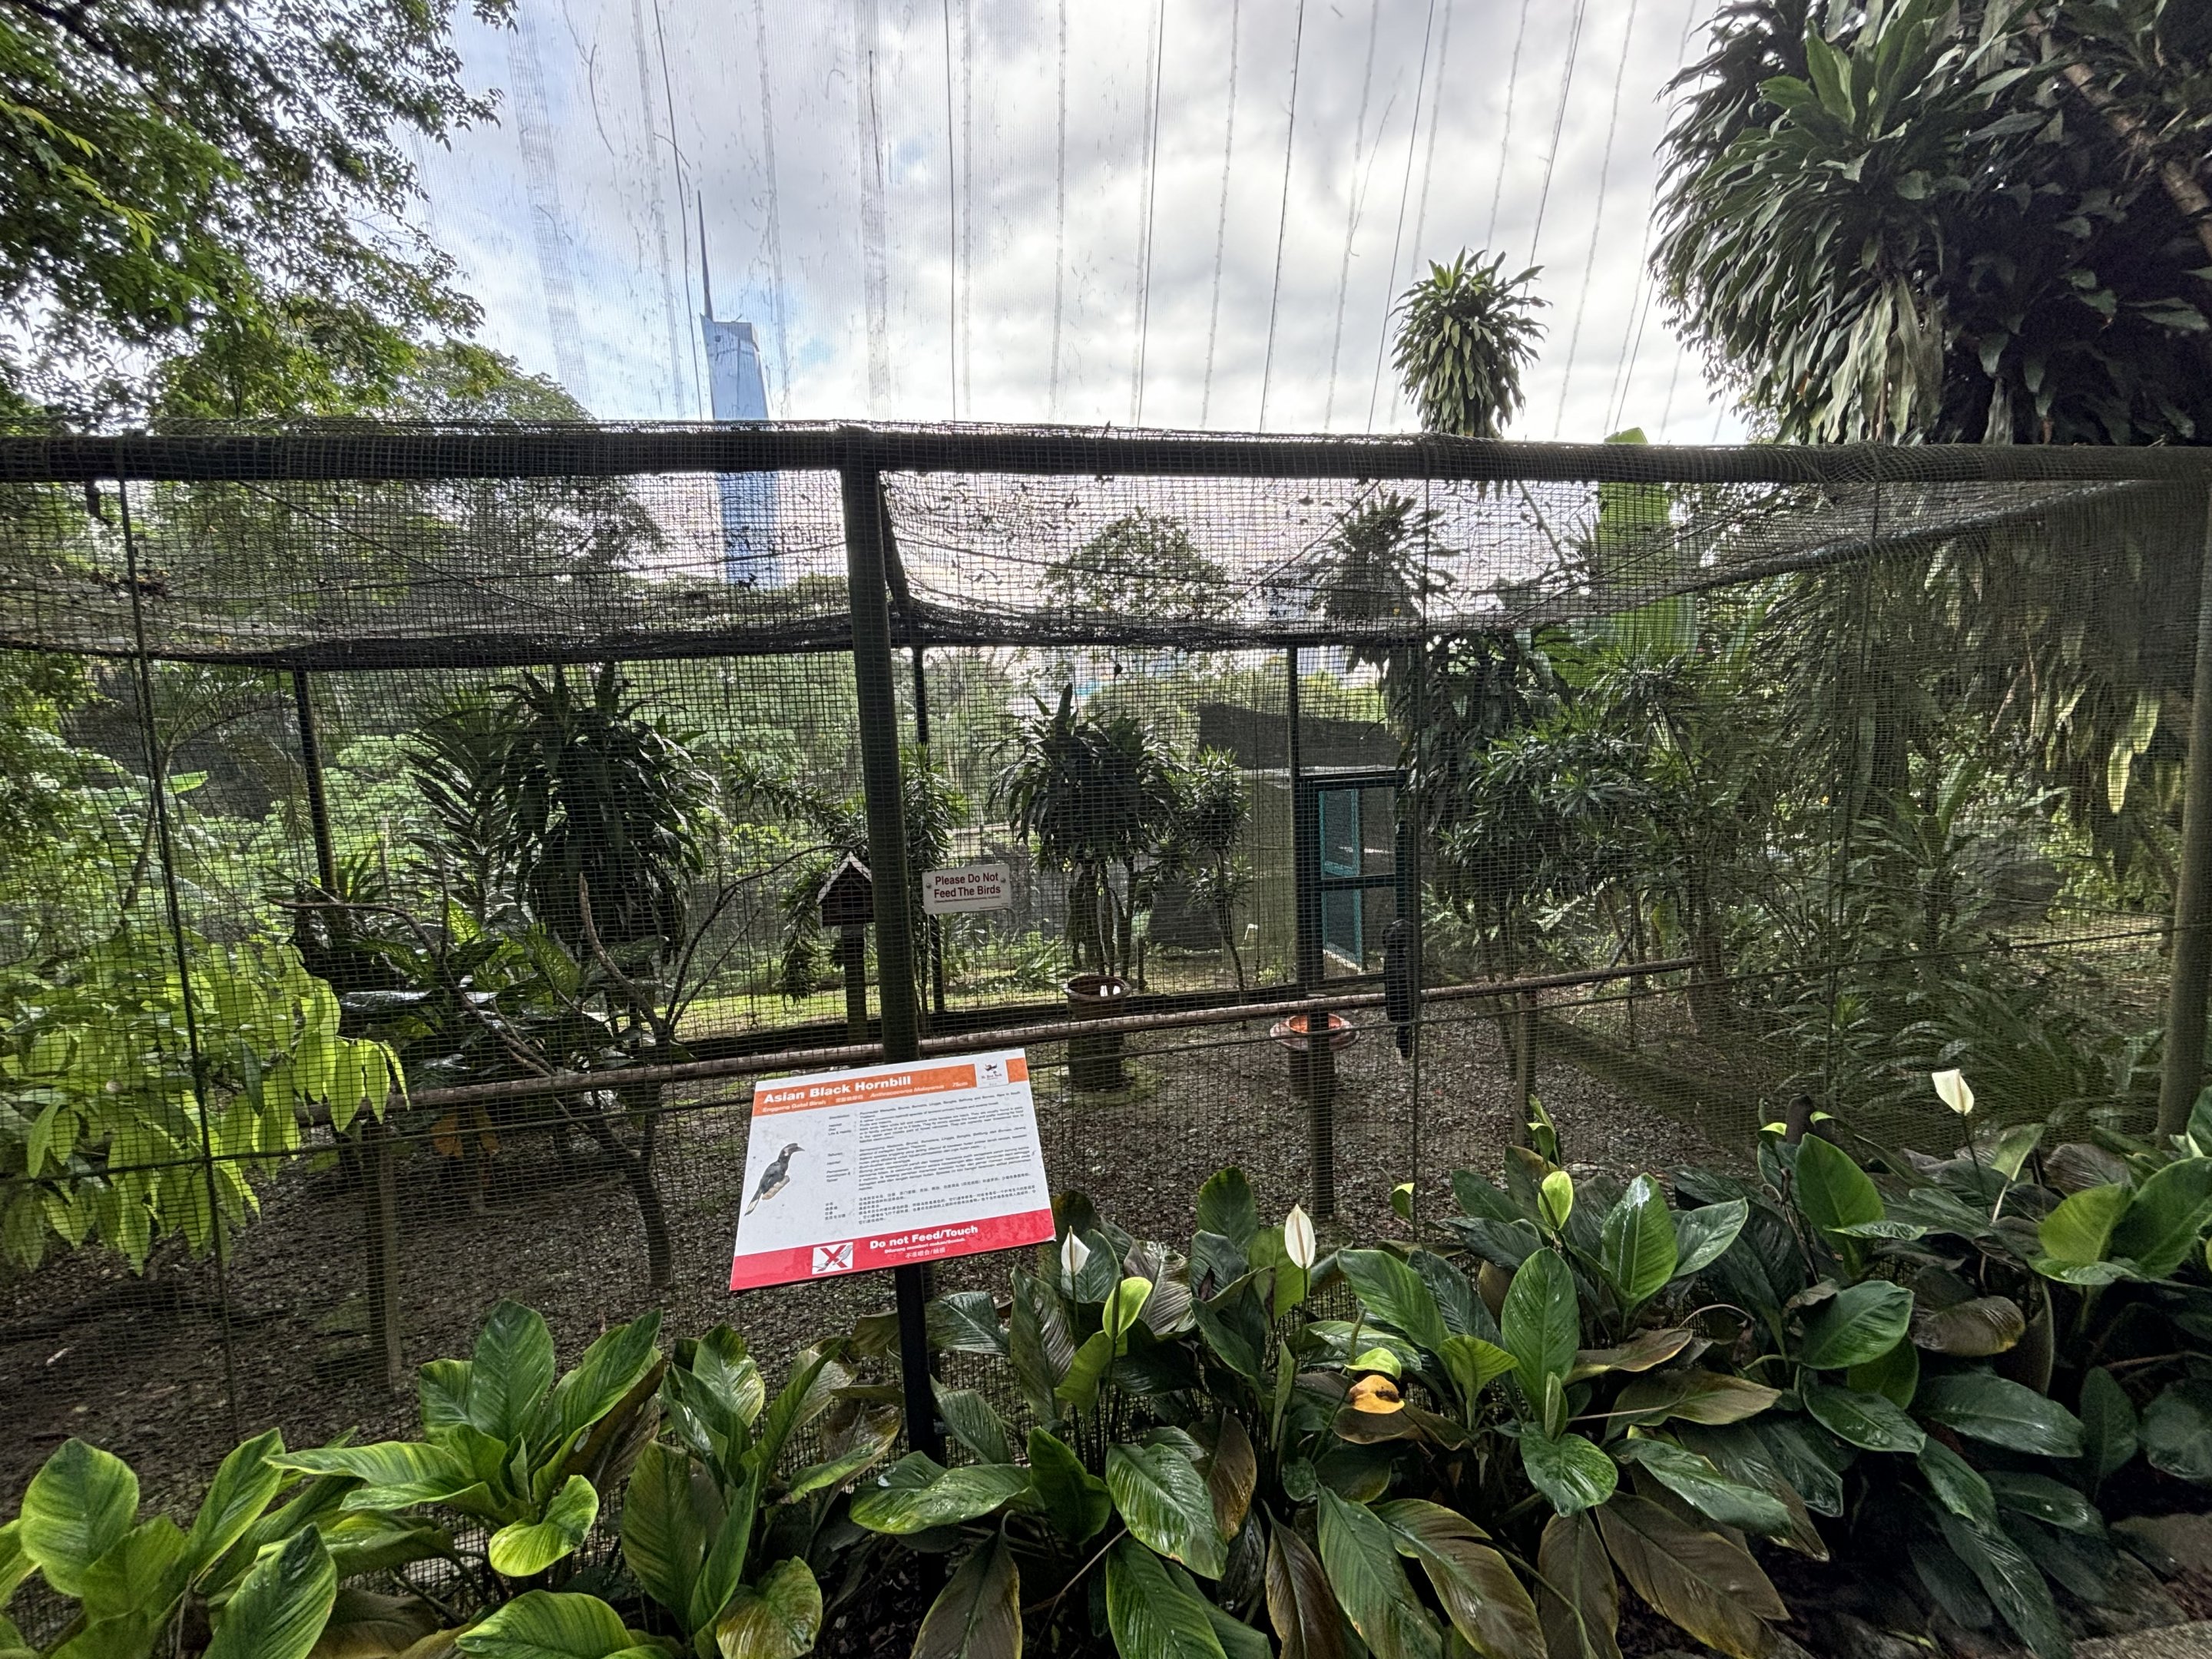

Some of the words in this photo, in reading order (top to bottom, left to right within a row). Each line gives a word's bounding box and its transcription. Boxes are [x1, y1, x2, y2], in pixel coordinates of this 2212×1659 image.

[935, 876, 965, 886] Please
[968, 873, 980, 883] Do
[982, 872, 998, 882] Not
[934, 888, 956, 899] Feed
[958, 886, 975, 896] The
[977, 885, 1001, 895] Birds
[763, 1091, 805, 1104] Asian
[810, 1084, 851, 1098] Black
[855, 1075, 911, 1091] Hornbill
[869, 1240, 886, 1250] Do
[889, 1236, 909, 1247] not
[912, 1225, 979, 1243] Feed/Touch
